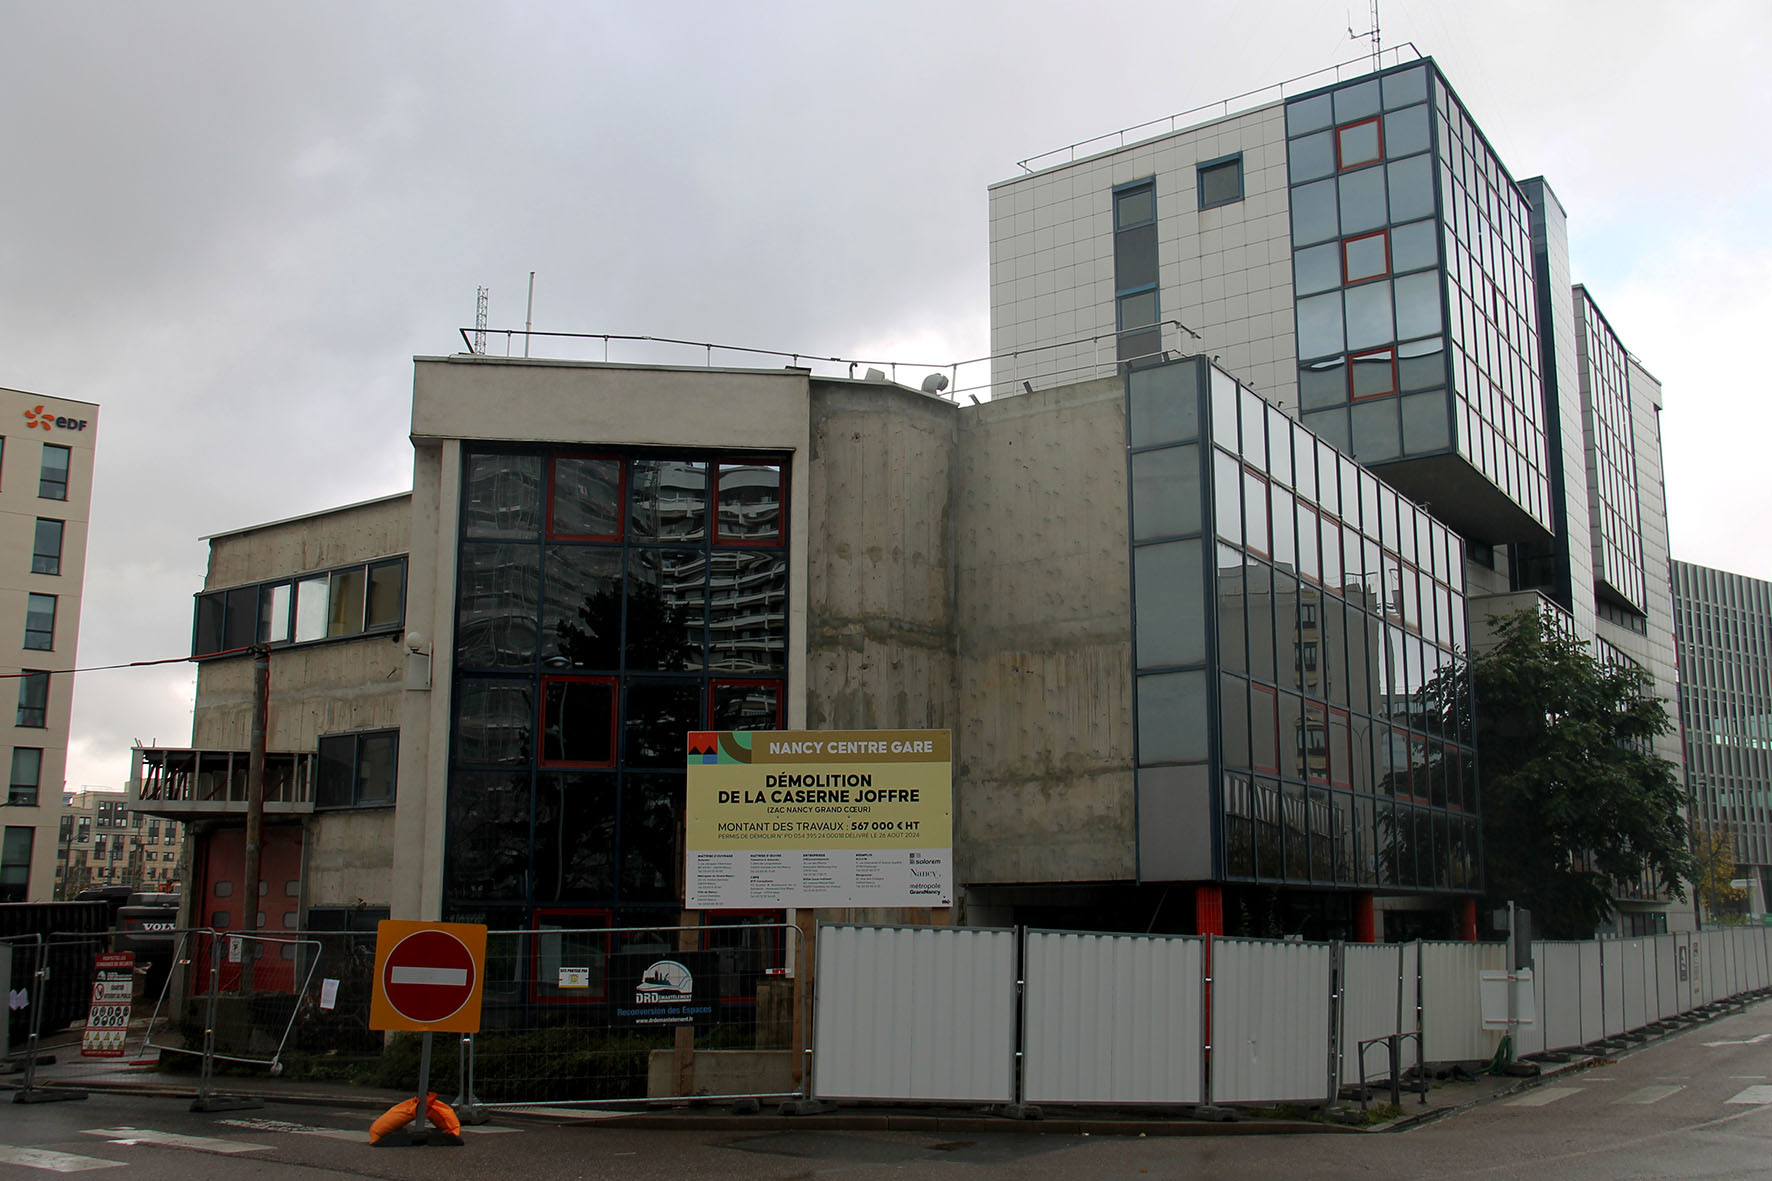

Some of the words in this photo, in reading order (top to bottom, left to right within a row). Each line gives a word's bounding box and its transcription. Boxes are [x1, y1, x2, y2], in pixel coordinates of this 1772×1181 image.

[769, 742, 824, 754] NANCY
[827, 741, 888, 753] CENTRE
[891, 741, 933, 753] GARE
[765, 772, 872, 788] DÉMOLITION
[718, 791, 740, 804] DE
[744, 790, 767, 804] LA
[770, 790, 850, 804] CASERNE
[854, 789, 920, 803] JOFFRE
[786, 806, 813, 814] NANCY
[814, 806, 842, 814] GRAND
[843, 805, 871, 814] CŒUR)
[718, 822, 770, 832] MONTANT
[772, 822, 794, 831] DES
[796, 821, 844, 831] TRAVAUX
[851, 821, 869, 831] 567
[871, 821, 894, 830] 000
[896, 821, 903, 830] €
[905, 821, 920, 830] HT
[911, 868, 938, 879] Nancy
[143, 922, 176, 931] VOLV
[617, 1007, 666, 1017] Reconversion
[667, 1006, 681, 1015] des
[682, 1005, 712, 1014] Espaces
